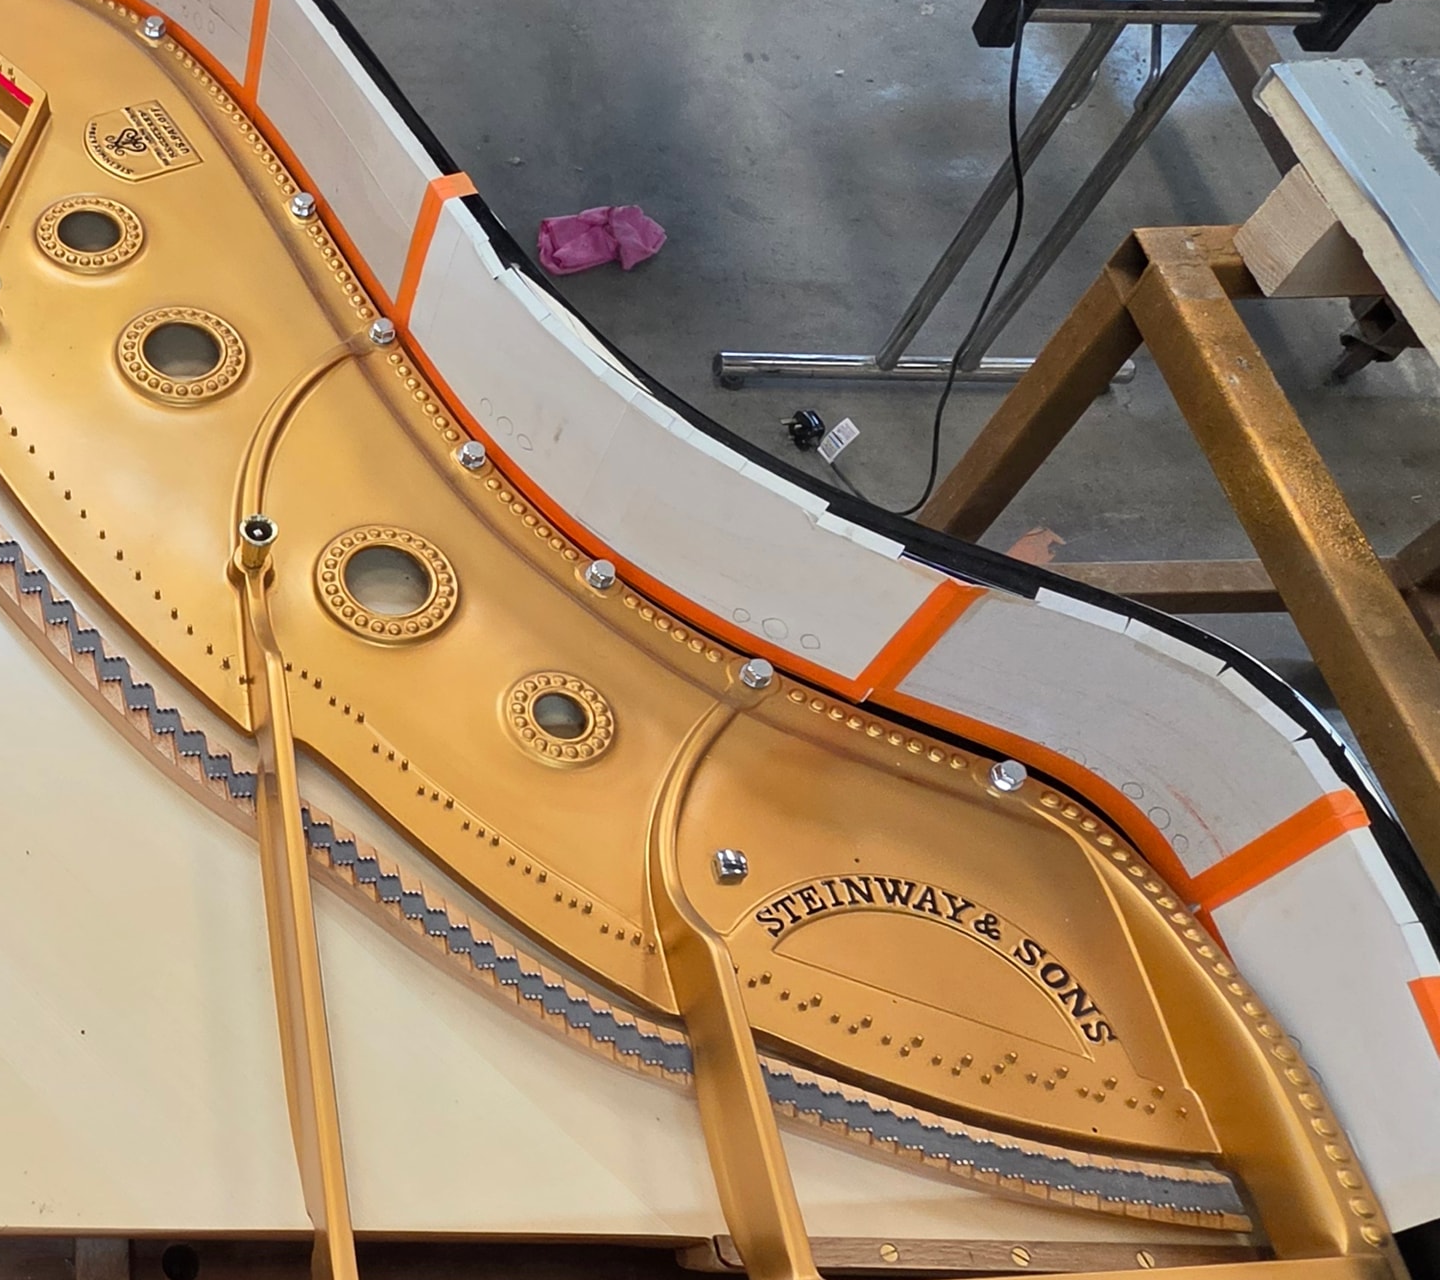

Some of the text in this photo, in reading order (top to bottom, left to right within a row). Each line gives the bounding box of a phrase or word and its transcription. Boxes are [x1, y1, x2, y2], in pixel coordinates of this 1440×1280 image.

[755, 876, 1117, 1046] STEINWAY & SONS
